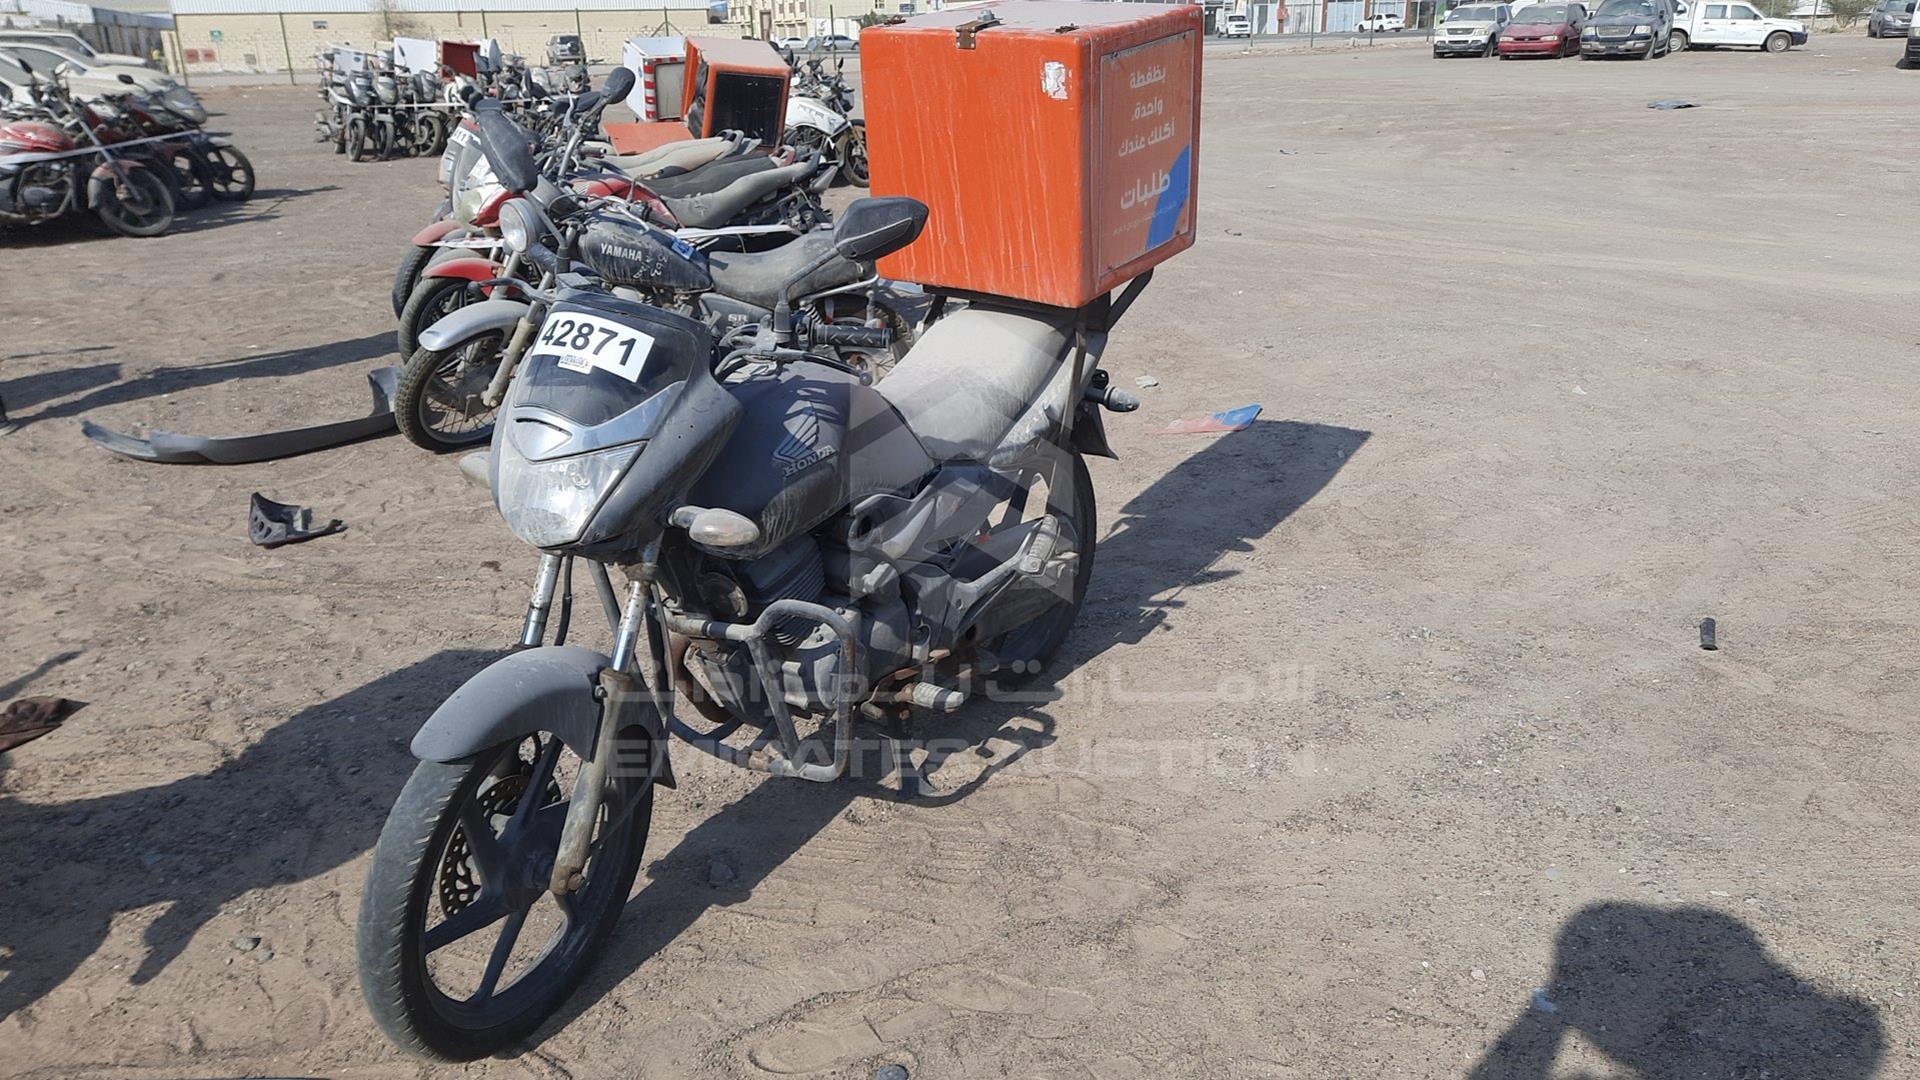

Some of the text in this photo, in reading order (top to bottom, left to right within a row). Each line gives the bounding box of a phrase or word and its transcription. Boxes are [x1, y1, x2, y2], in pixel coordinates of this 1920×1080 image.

[1120, 169, 1171, 210] طلبات
[600, 242, 643, 262] YAMAHA
[541, 319, 637, 367] 42871
[783, 444, 839, 477] HONDA
